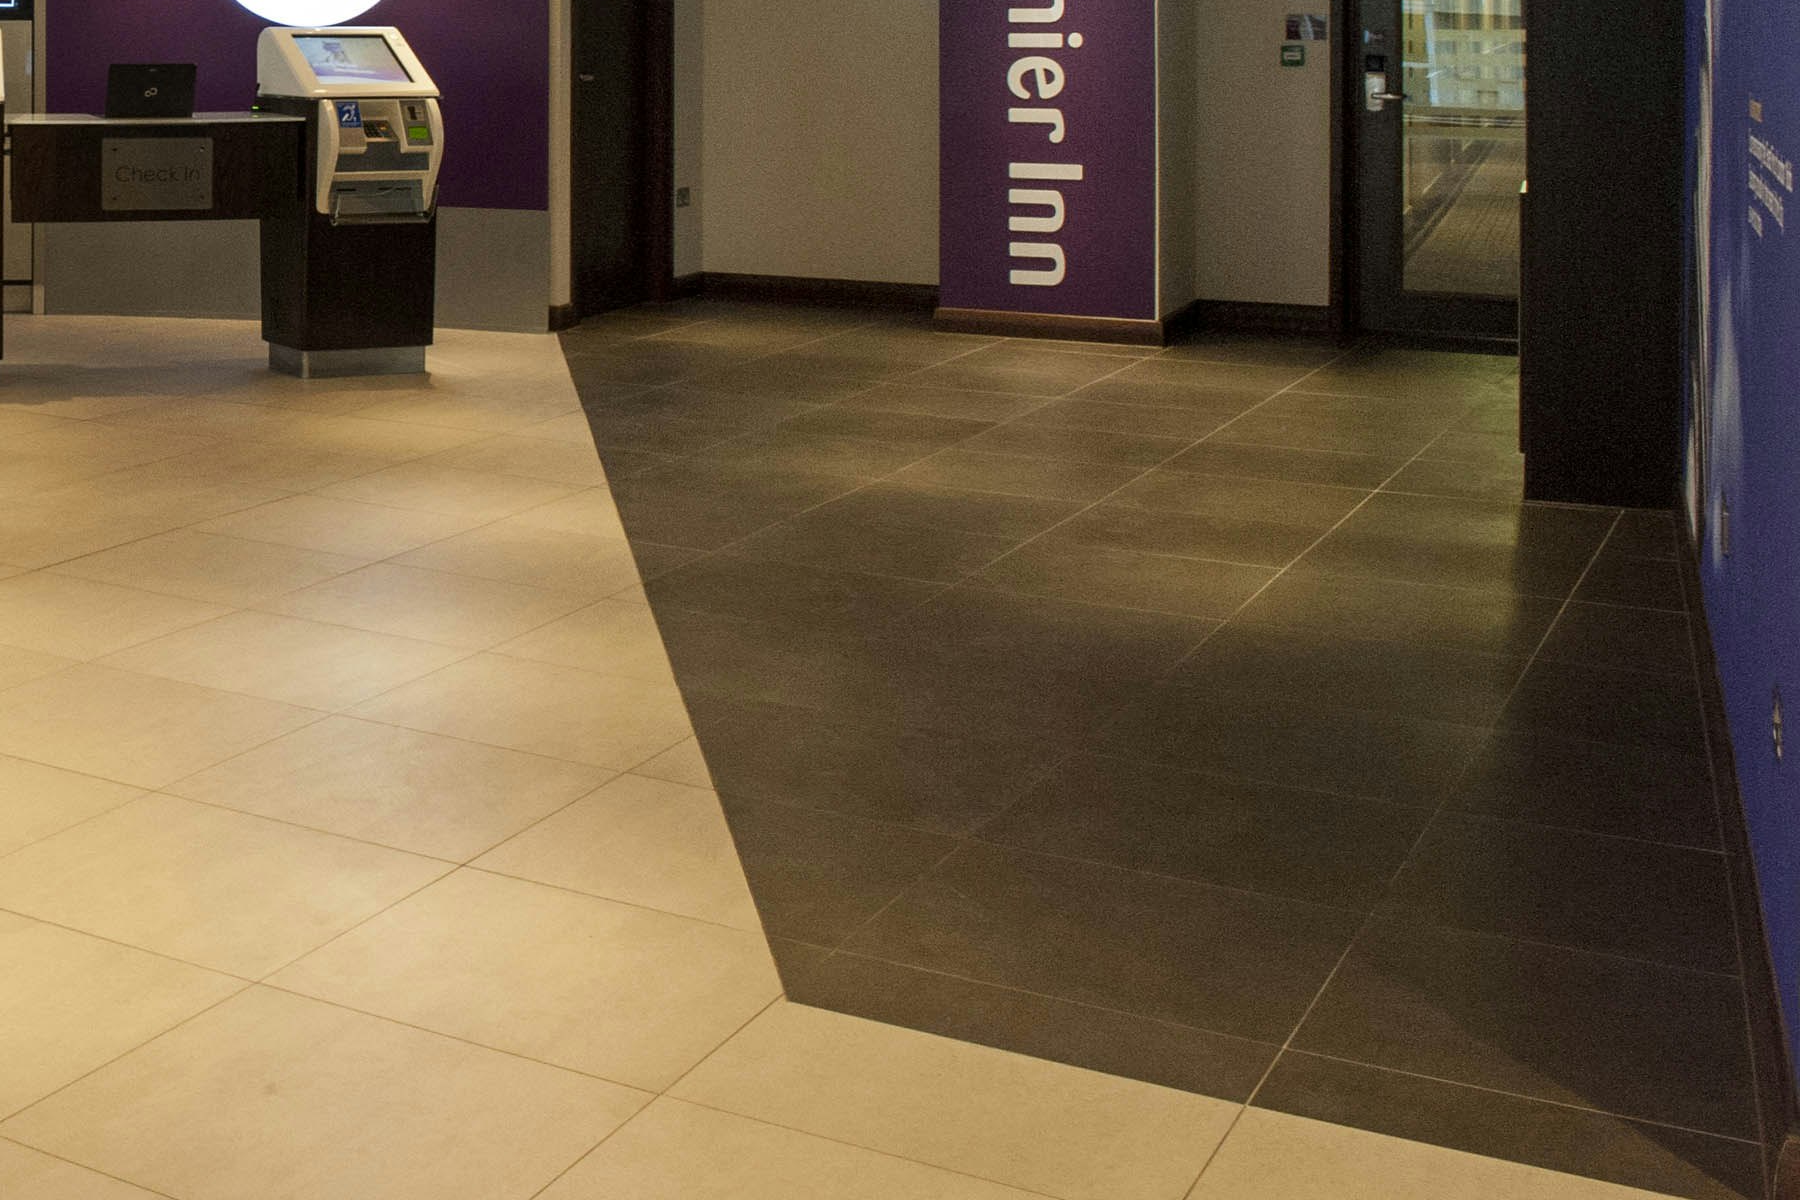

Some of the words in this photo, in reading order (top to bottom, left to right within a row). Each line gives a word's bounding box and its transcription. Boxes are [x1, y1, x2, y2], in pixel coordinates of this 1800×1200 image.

[114, 165, 179, 183] Check
[184, 166, 200, 183] In
[1007, 162, 1083, 287] Inn
